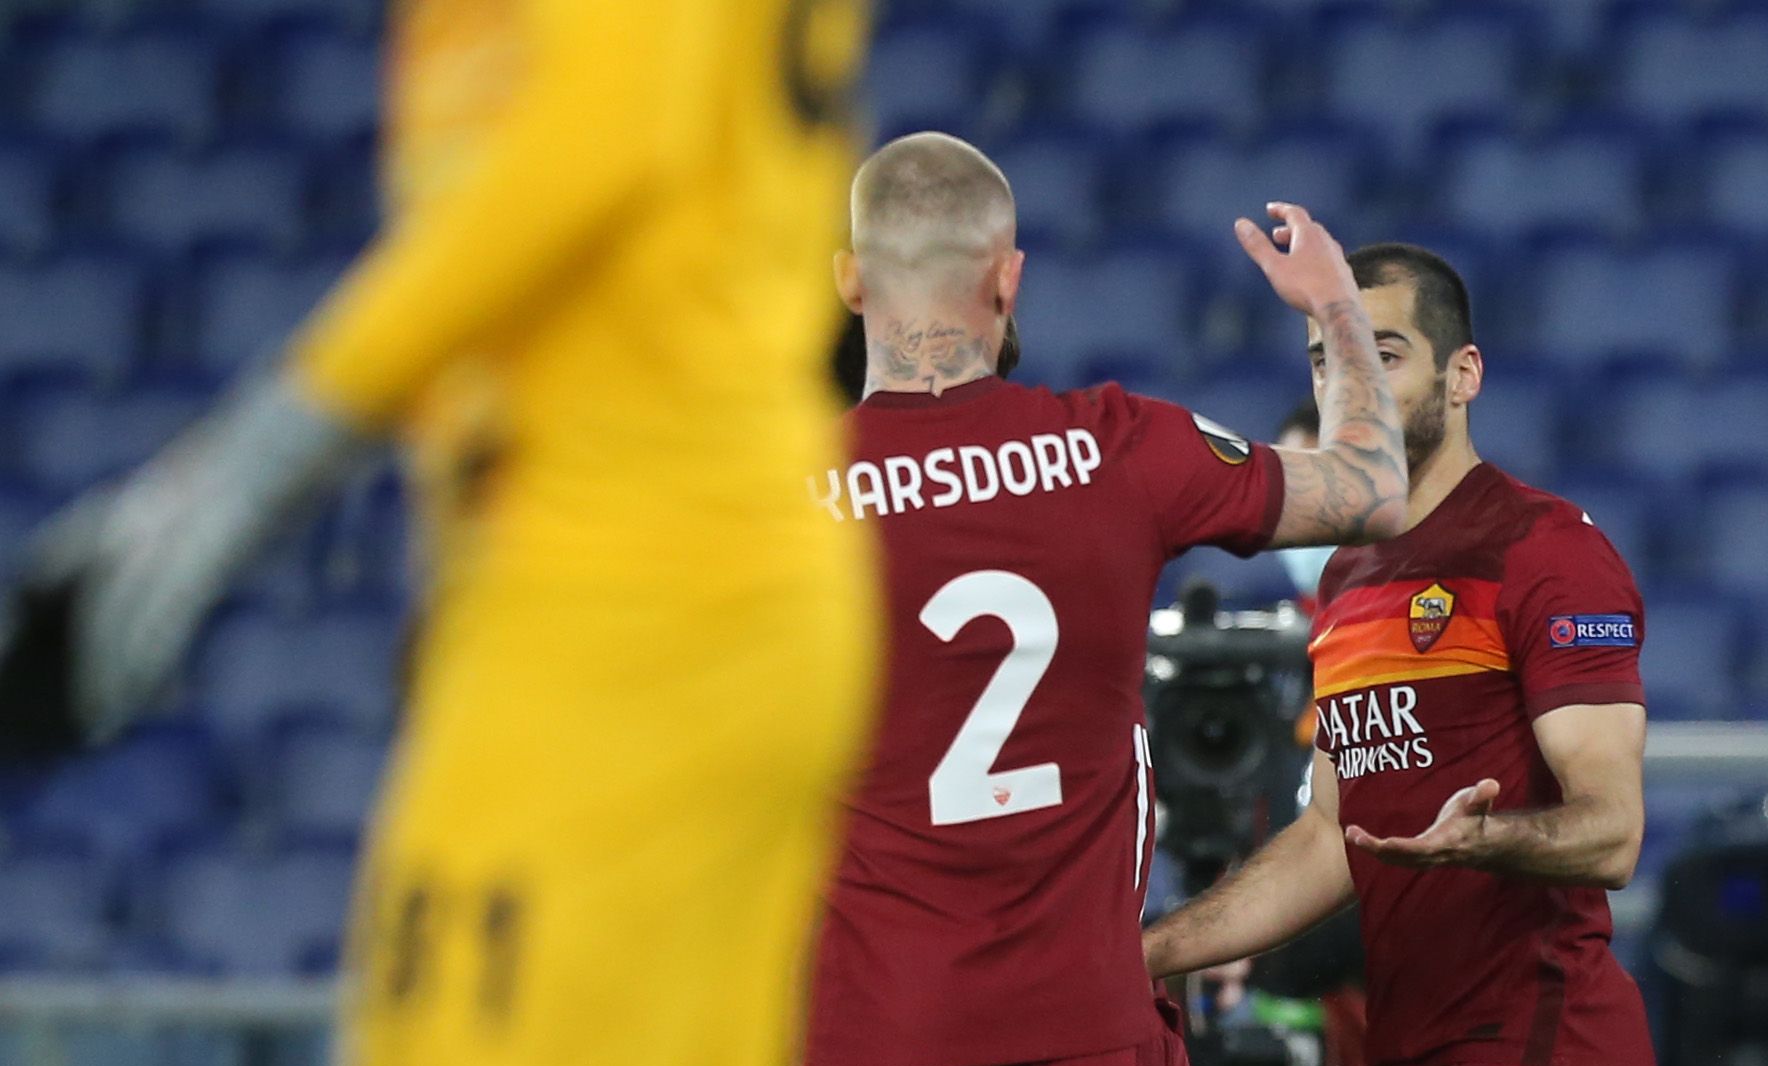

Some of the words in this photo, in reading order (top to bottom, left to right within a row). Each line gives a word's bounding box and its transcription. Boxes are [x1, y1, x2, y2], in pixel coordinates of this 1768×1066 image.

[1577, 623, 1633, 638] RESPECT
[918, 569, 1063, 826] 2
[1316, 685, 1425, 750] ATAR
[1337, 736, 1434, 779] AIRWAYS
